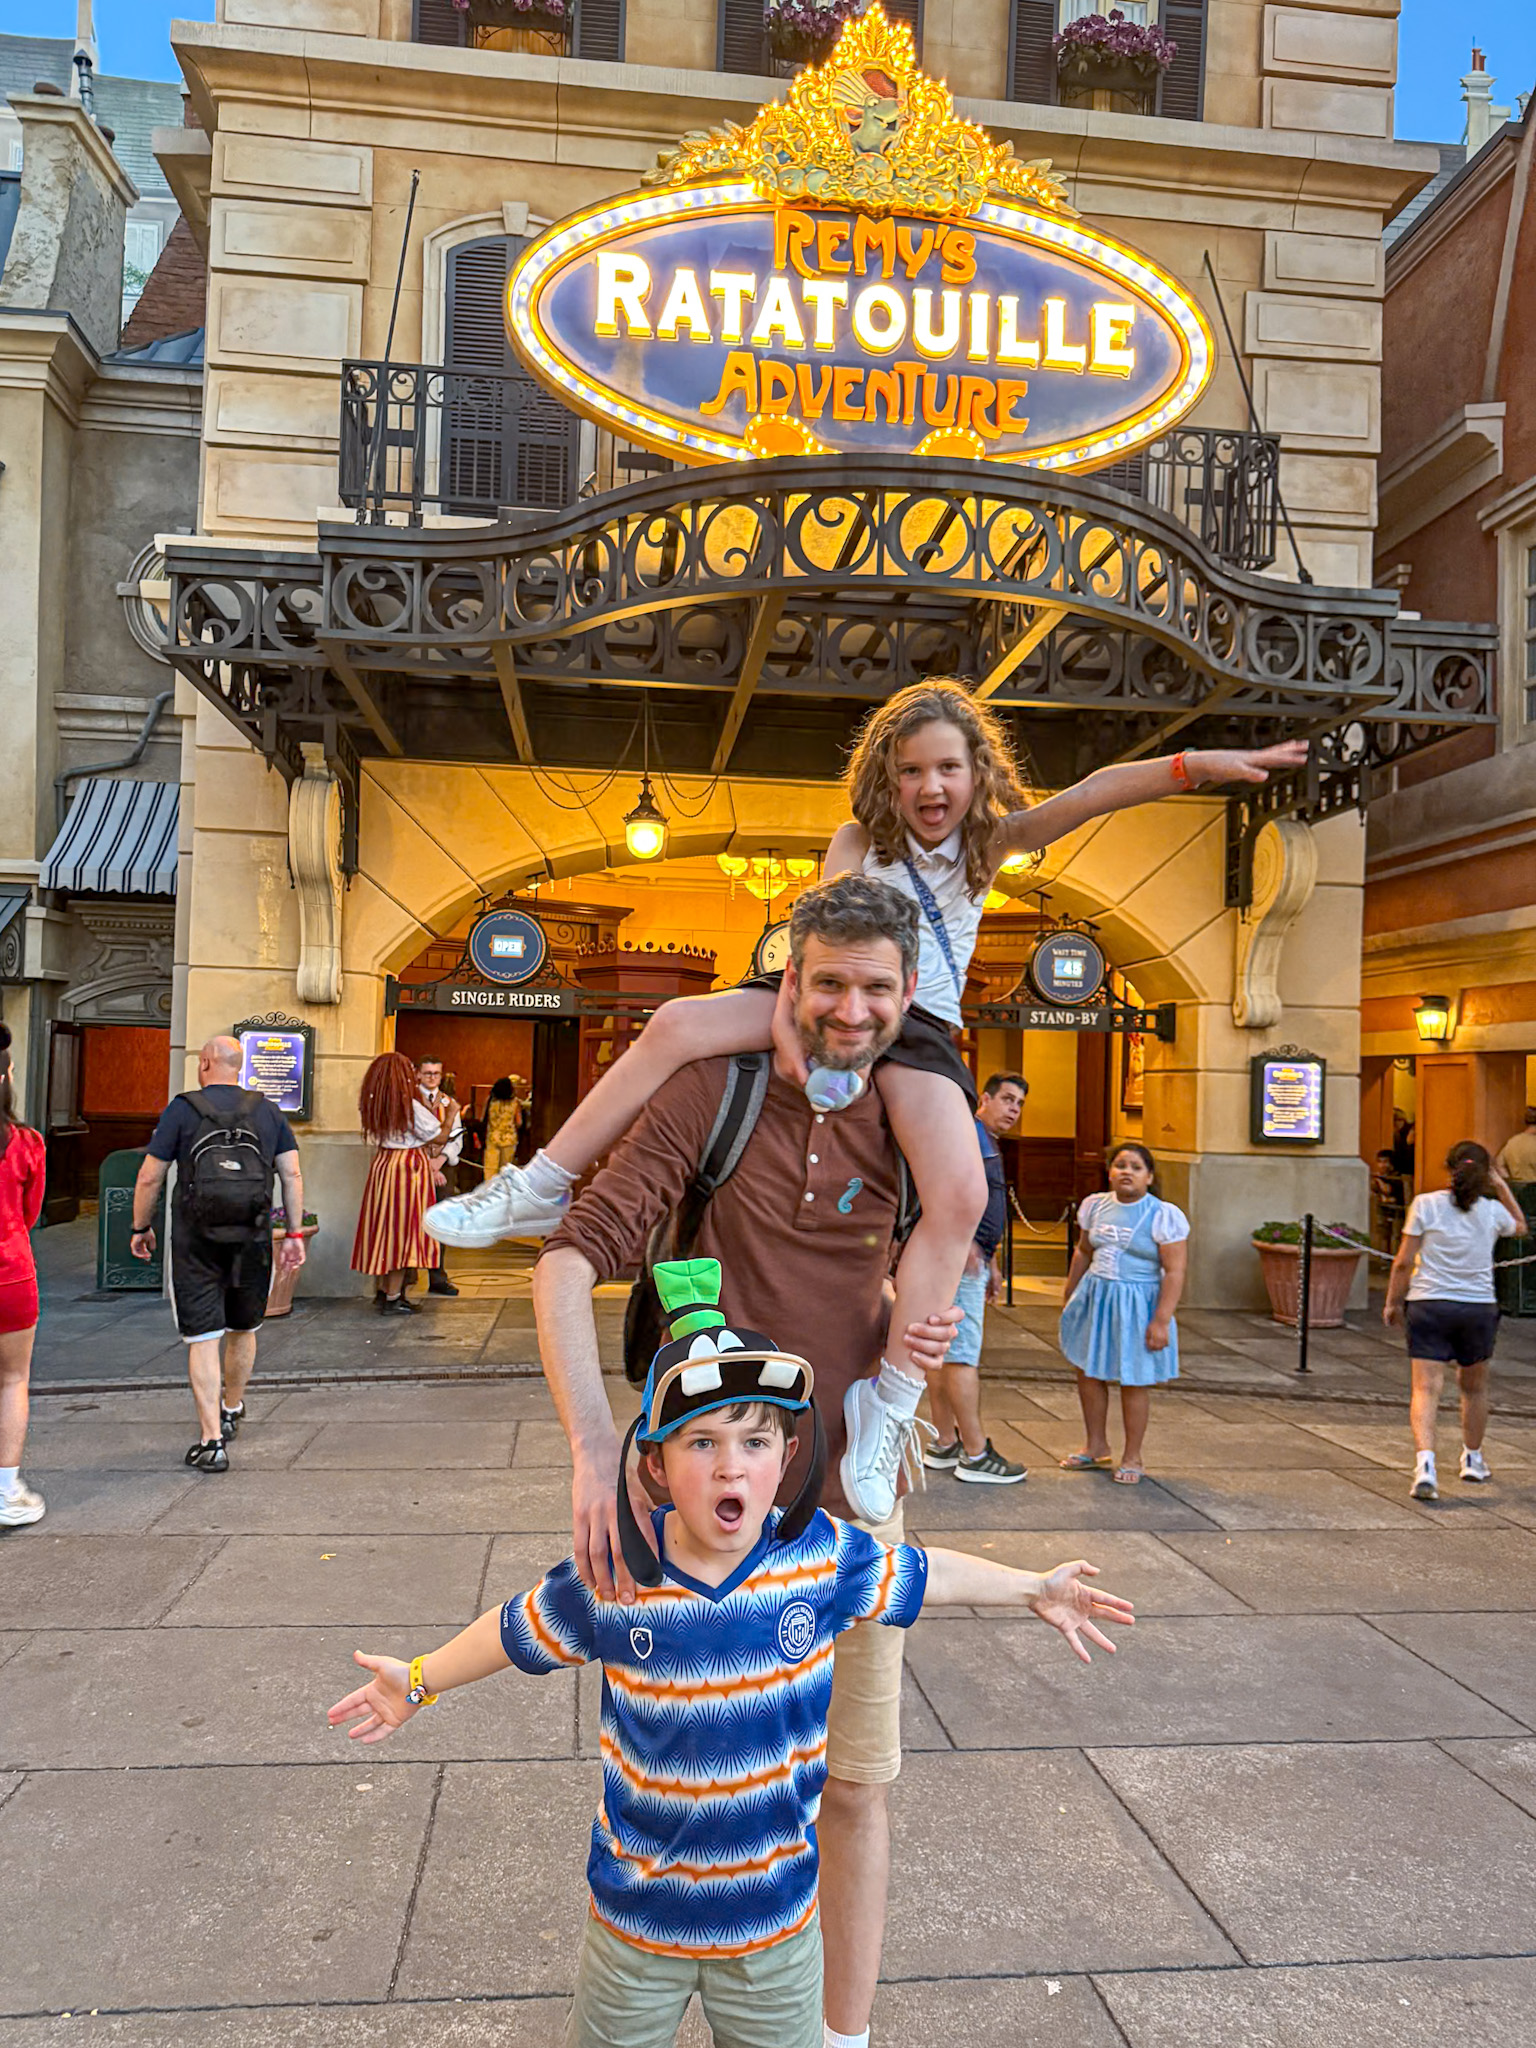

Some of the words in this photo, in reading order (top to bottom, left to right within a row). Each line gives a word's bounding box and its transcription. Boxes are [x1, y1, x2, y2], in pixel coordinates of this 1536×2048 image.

[774, 209, 978, 284] REMY'S
[593, 250, 1138, 380] RATATOUILLE
[700, 350, 1031, 439] ADVENTURE
[494, 940, 522, 953] OPEN
[768, 951, 775, 963] 9
[451, 991, 505, 1006] SINGLE
[508, 993, 561, 1009] RIDERS
[1029, 1010, 1099, 1026] STAND-BY
